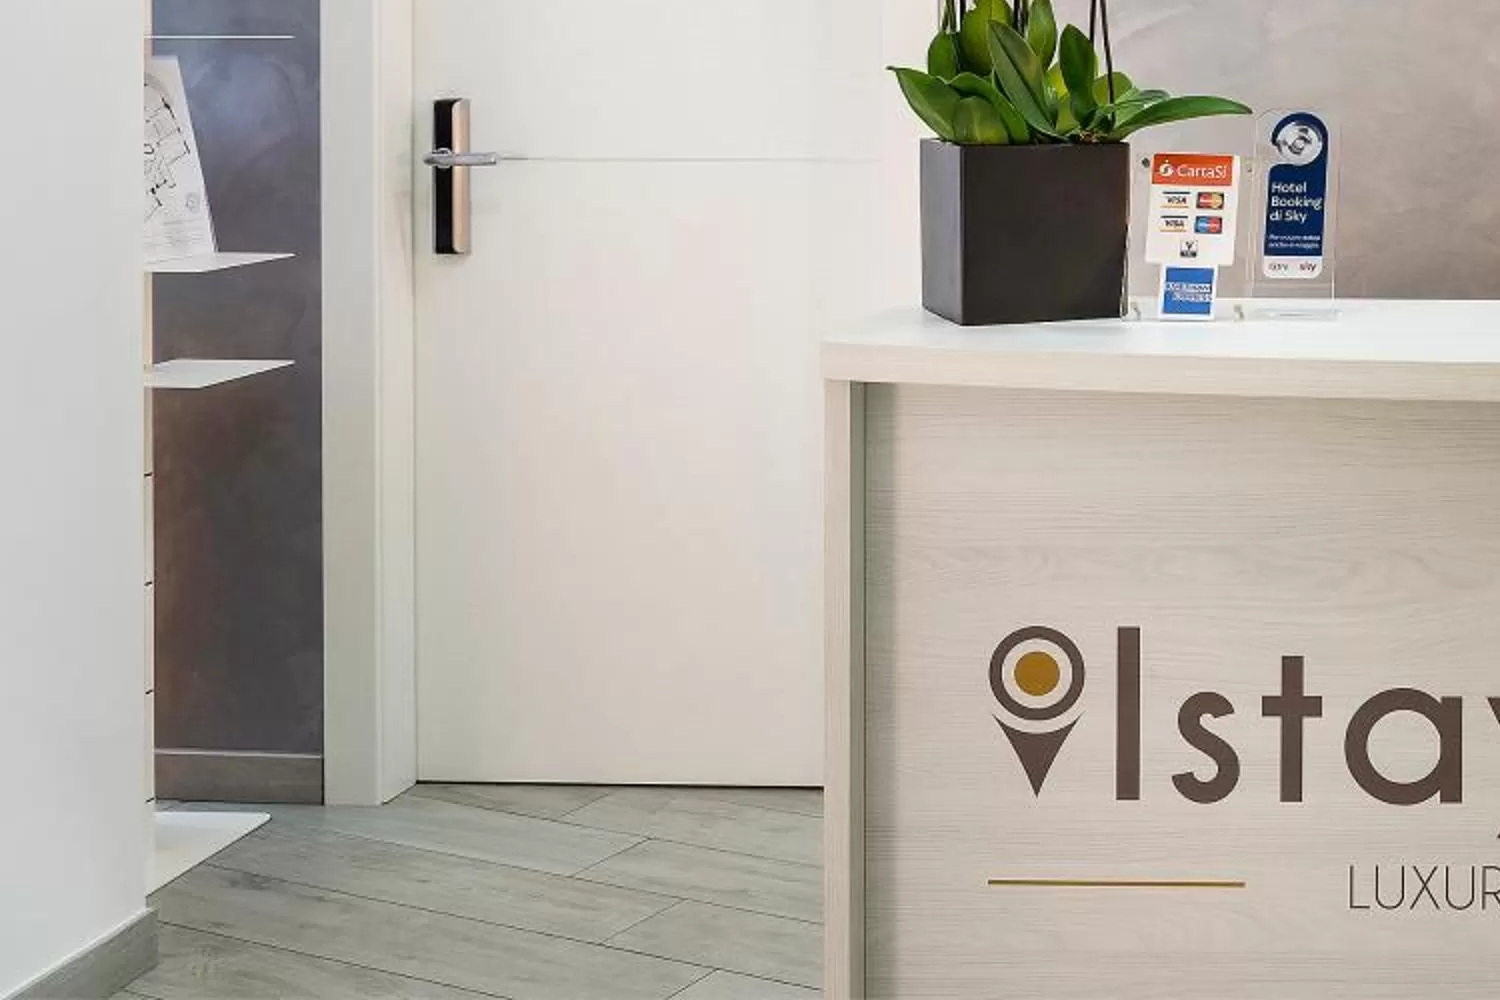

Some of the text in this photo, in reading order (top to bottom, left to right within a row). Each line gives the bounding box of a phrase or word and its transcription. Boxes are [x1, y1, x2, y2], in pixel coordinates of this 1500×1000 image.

[1271, 181, 1307, 193] Hotel
[1271, 195, 1323, 211] Booking
[1269, 209, 1308, 224] di Sky
